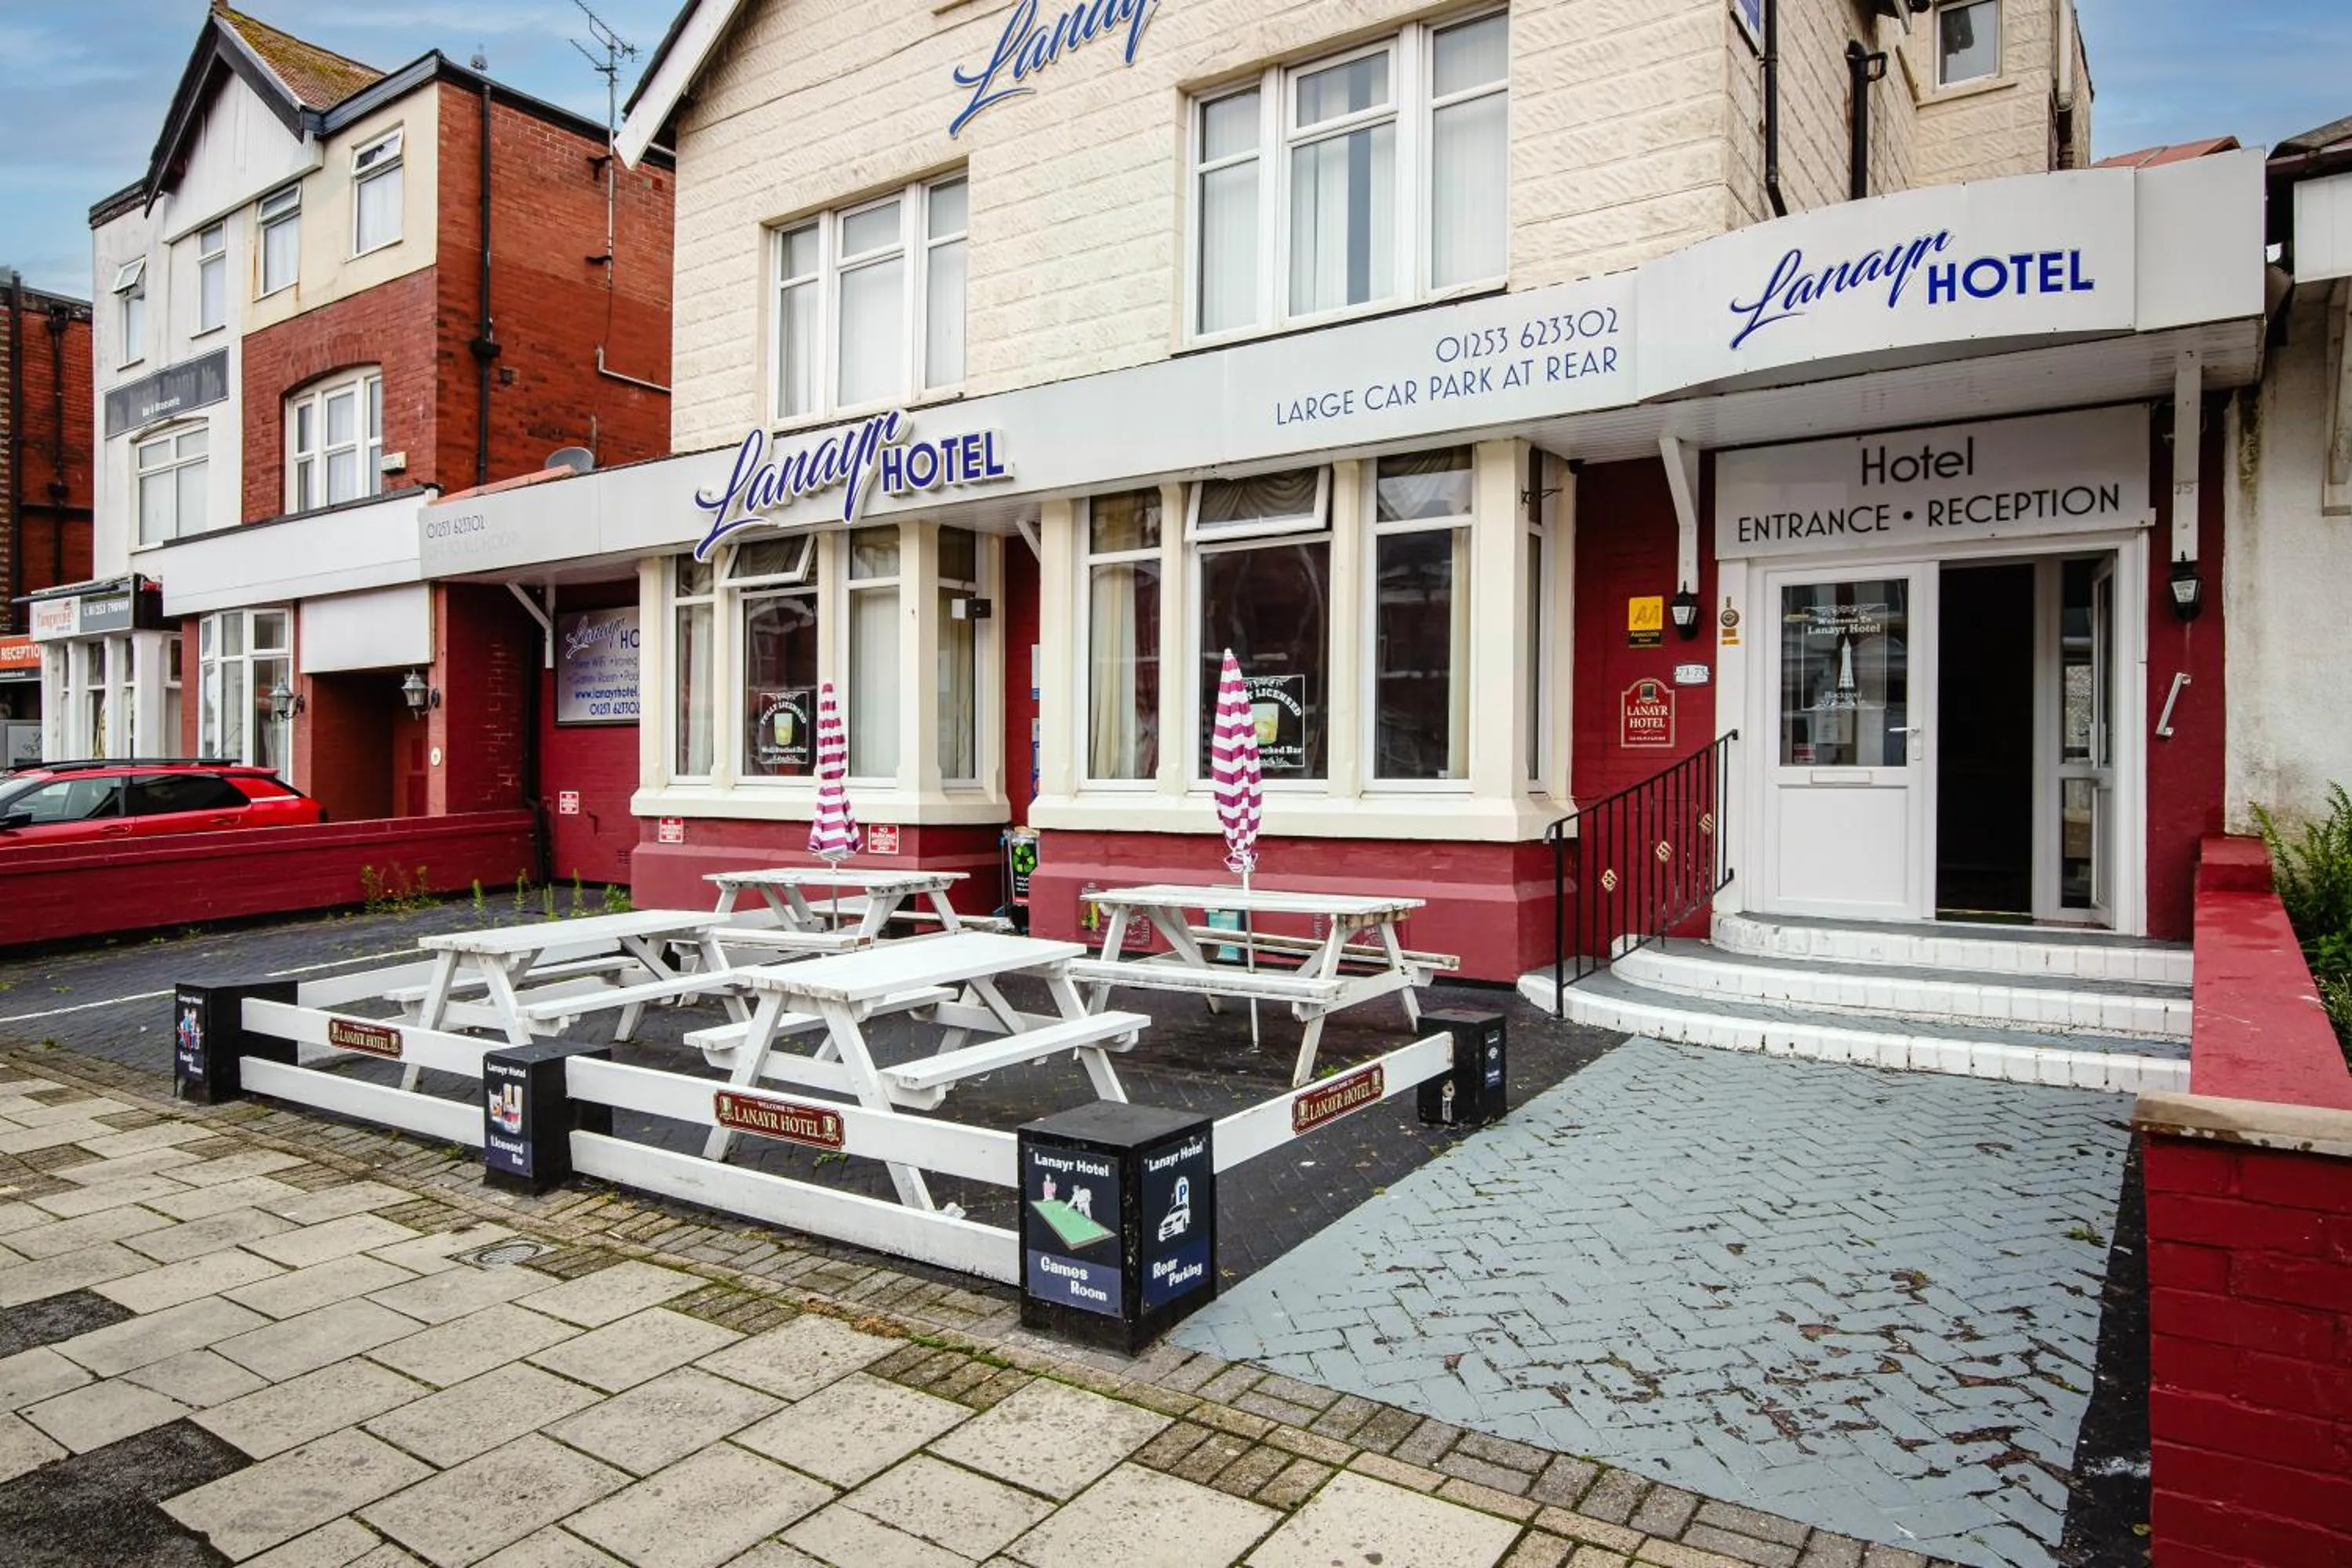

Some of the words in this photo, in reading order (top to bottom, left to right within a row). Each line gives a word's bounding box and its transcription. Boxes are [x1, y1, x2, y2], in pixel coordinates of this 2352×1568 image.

[949, 0, 1149, 138] Lanay
[1730, 229, 1951, 350] Lanayr
[1928, 249, 2093, 306] HOTEL
[1436, 327, 1508, 363] 01253
[1520, 307, 1619, 349] 623302
[1277, 390, 1355, 426] LARGE
[1364, 380, 1417, 411] CAR
[1429, 366, 1493, 401] PARK
[1502, 360, 1534, 390] AT
[1546, 347, 1618, 382] REAR
[1861, 436, 1973, 486] Hotel
[695, 409, 903, 561] Lanayr
[881, 429, 1006, 494] HOTEL
[1738, 504, 1890, 543] ENTRANCE
[1928, 483, 2119, 528] RECEPTION
[1807, 626, 1846, 637] Lanayr
[1849, 623, 1881, 634] Hotel
[1, 644, 42, 662] RECEPTIO
[1255, 688, 1302, 717] LICENSED
[1627, 705, 1668, 716] LANAYR
[1630, 717, 1666, 728] HOTEL
[487, 1062, 507, 1076] Lanayr
[509, 1066, 526, 1078] Hotel
[1310, 1094, 1343, 1120] LANAYR
[1344, 1082, 1370, 1106] HOTEL
[735, 1105, 779, 1129] LANAYR
[781, 1116, 821, 1138] HOTEL
[490, 1135, 524, 1155] Licensed
[1149, 1152, 1179, 1172] Lanayr
[1180, 1142, 1203, 1160] Hotel
[1034, 1152, 1074, 1172] Lanayr
[1076, 1159, 1109, 1177] Hotel
[1040, 1256, 1089, 1280] Games
[1152, 1258, 1178, 1279] Rear
[1168, 1262, 1203, 1287] Parking
[1070, 1279, 1108, 1302] Room
